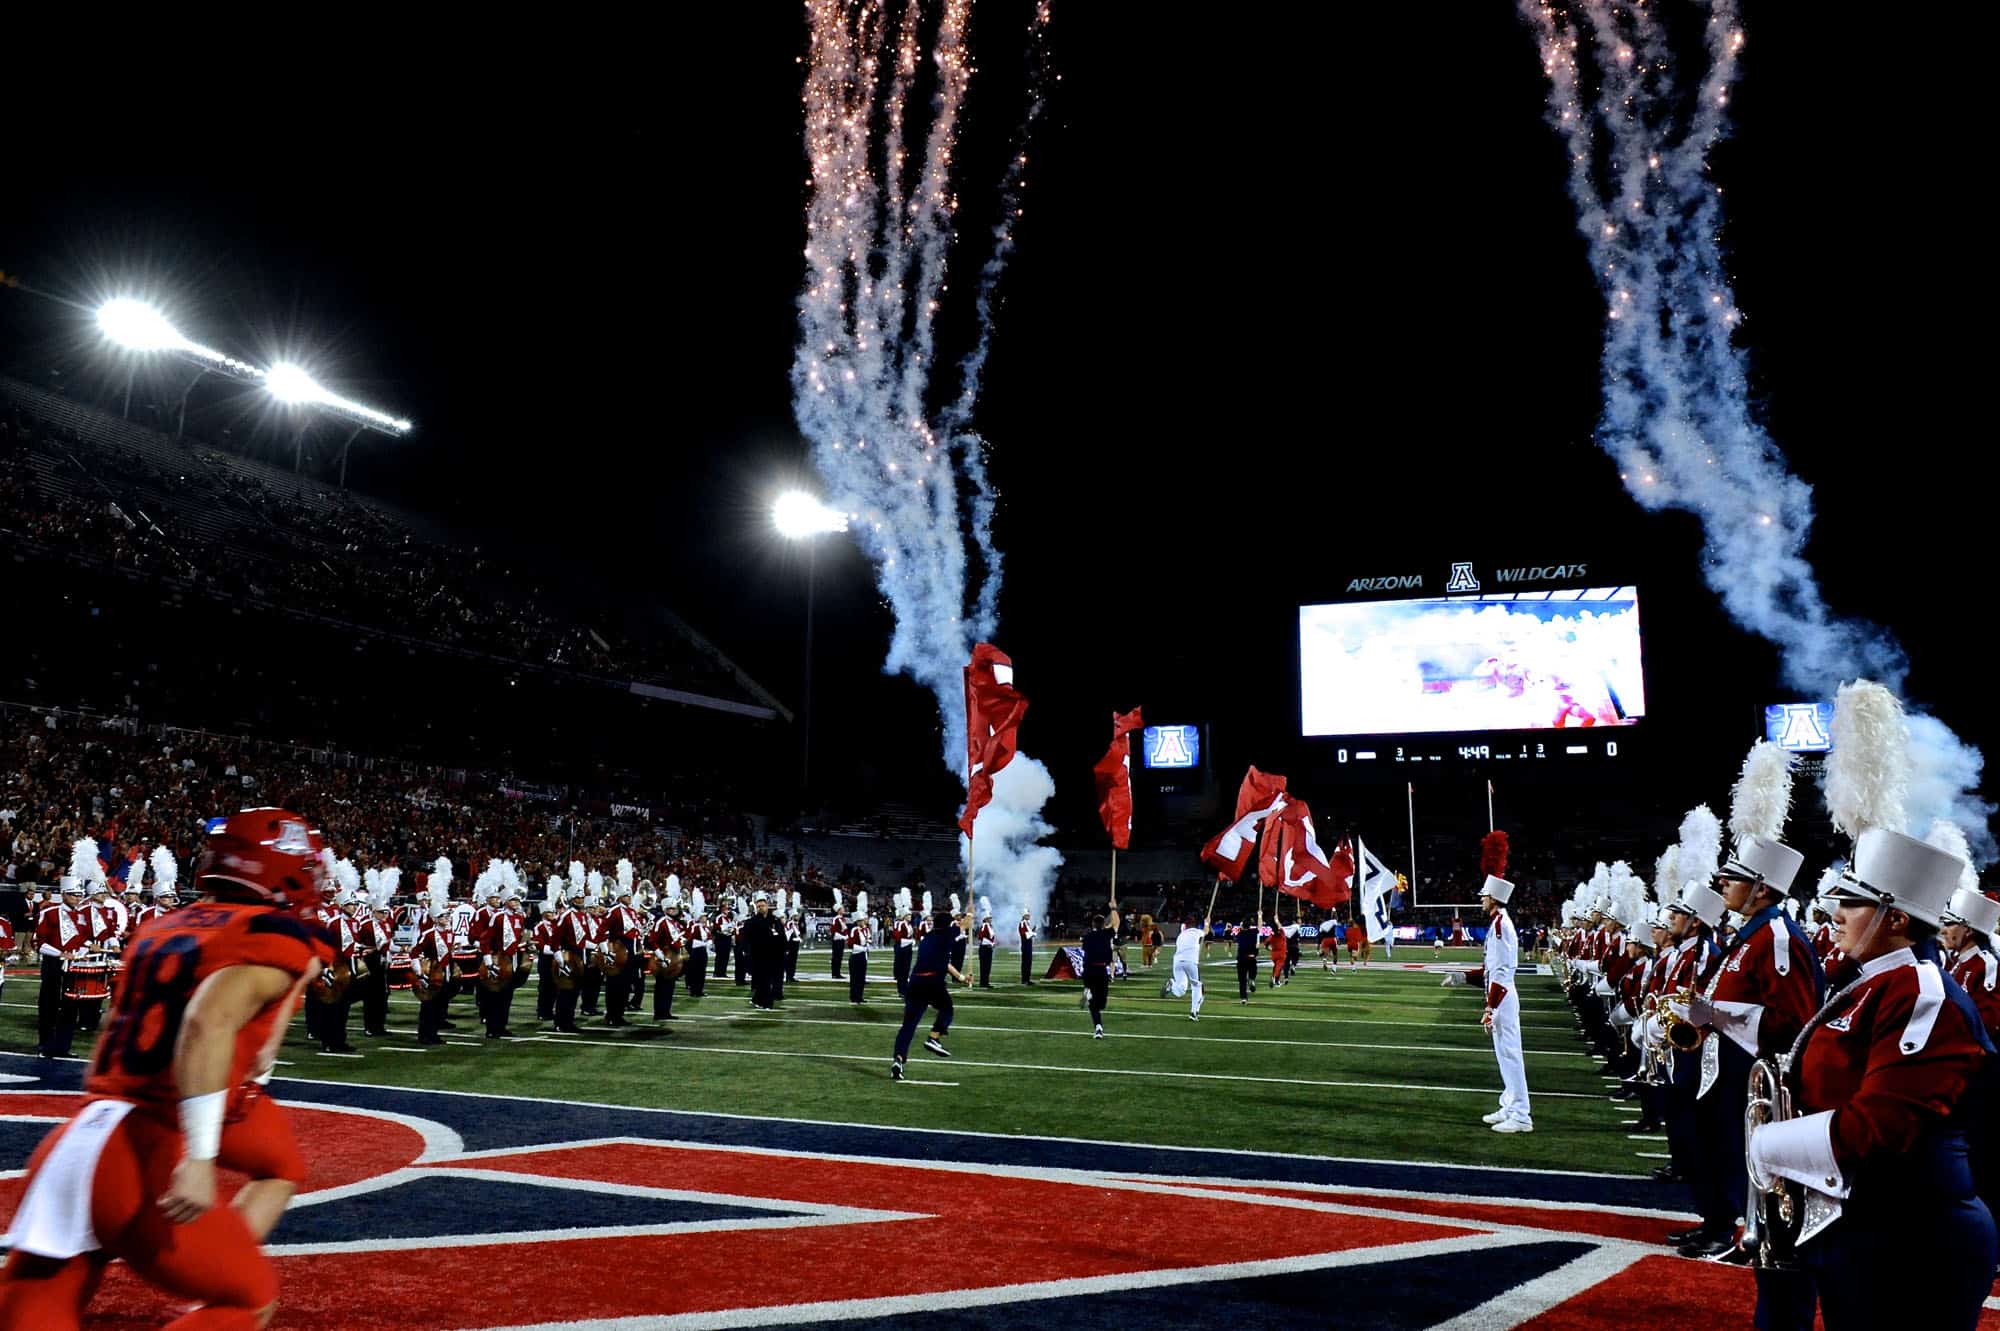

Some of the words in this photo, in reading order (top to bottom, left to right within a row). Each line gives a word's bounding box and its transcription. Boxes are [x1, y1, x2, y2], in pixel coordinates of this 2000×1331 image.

[1446, 561, 1481, 593] A
[1496, 563, 1588, 584] WILDCATS
[1345, 575, 1424, 593] ARIZONA
[1151, 726, 1193, 767] A
[1458, 745, 1490, 760] 4:49
[1606, 741, 1617, 757] 0
[1338, 749, 1348, 763] 0
